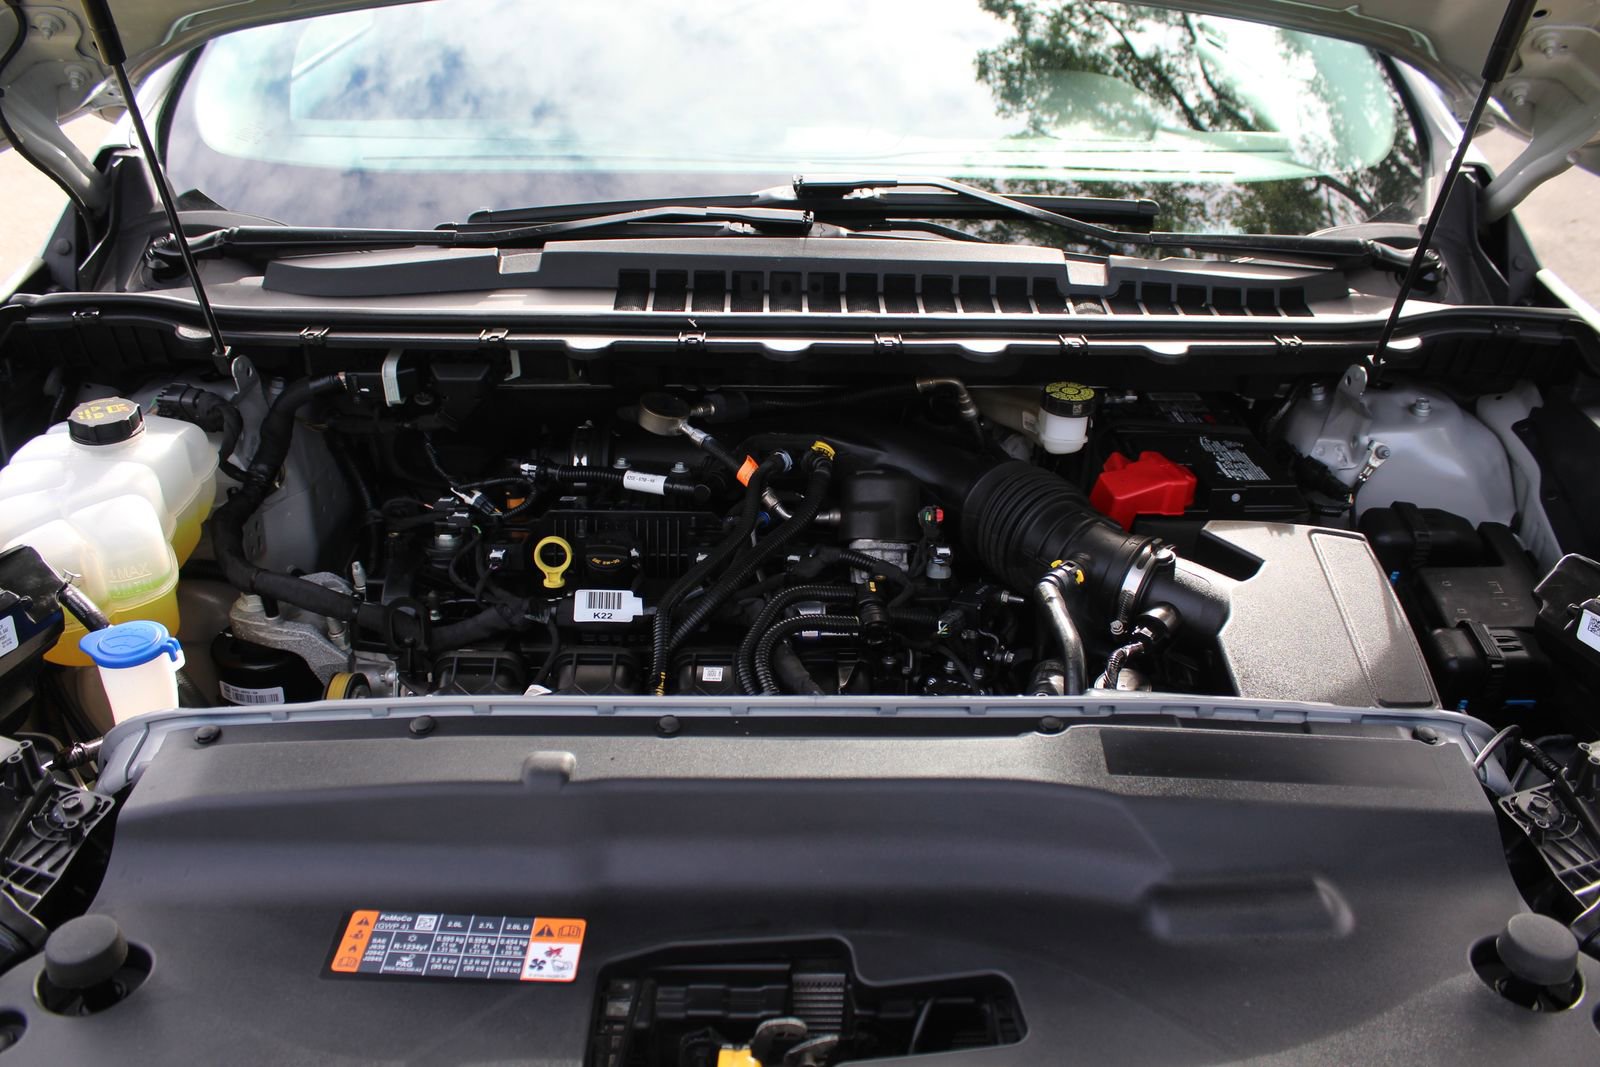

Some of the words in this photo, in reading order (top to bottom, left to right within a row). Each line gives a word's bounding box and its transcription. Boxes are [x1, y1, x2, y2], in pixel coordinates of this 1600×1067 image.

[117, 562, 151, 579] MAX
[380, 914, 412, 922] FoMoCo
[455, 936, 464, 944] kg
[488, 937, 497, 945] kg
[519, 939, 528, 947] kg
[393, 943, 428, 951] R-1234yf
[395, 960, 413, 968] PAG
